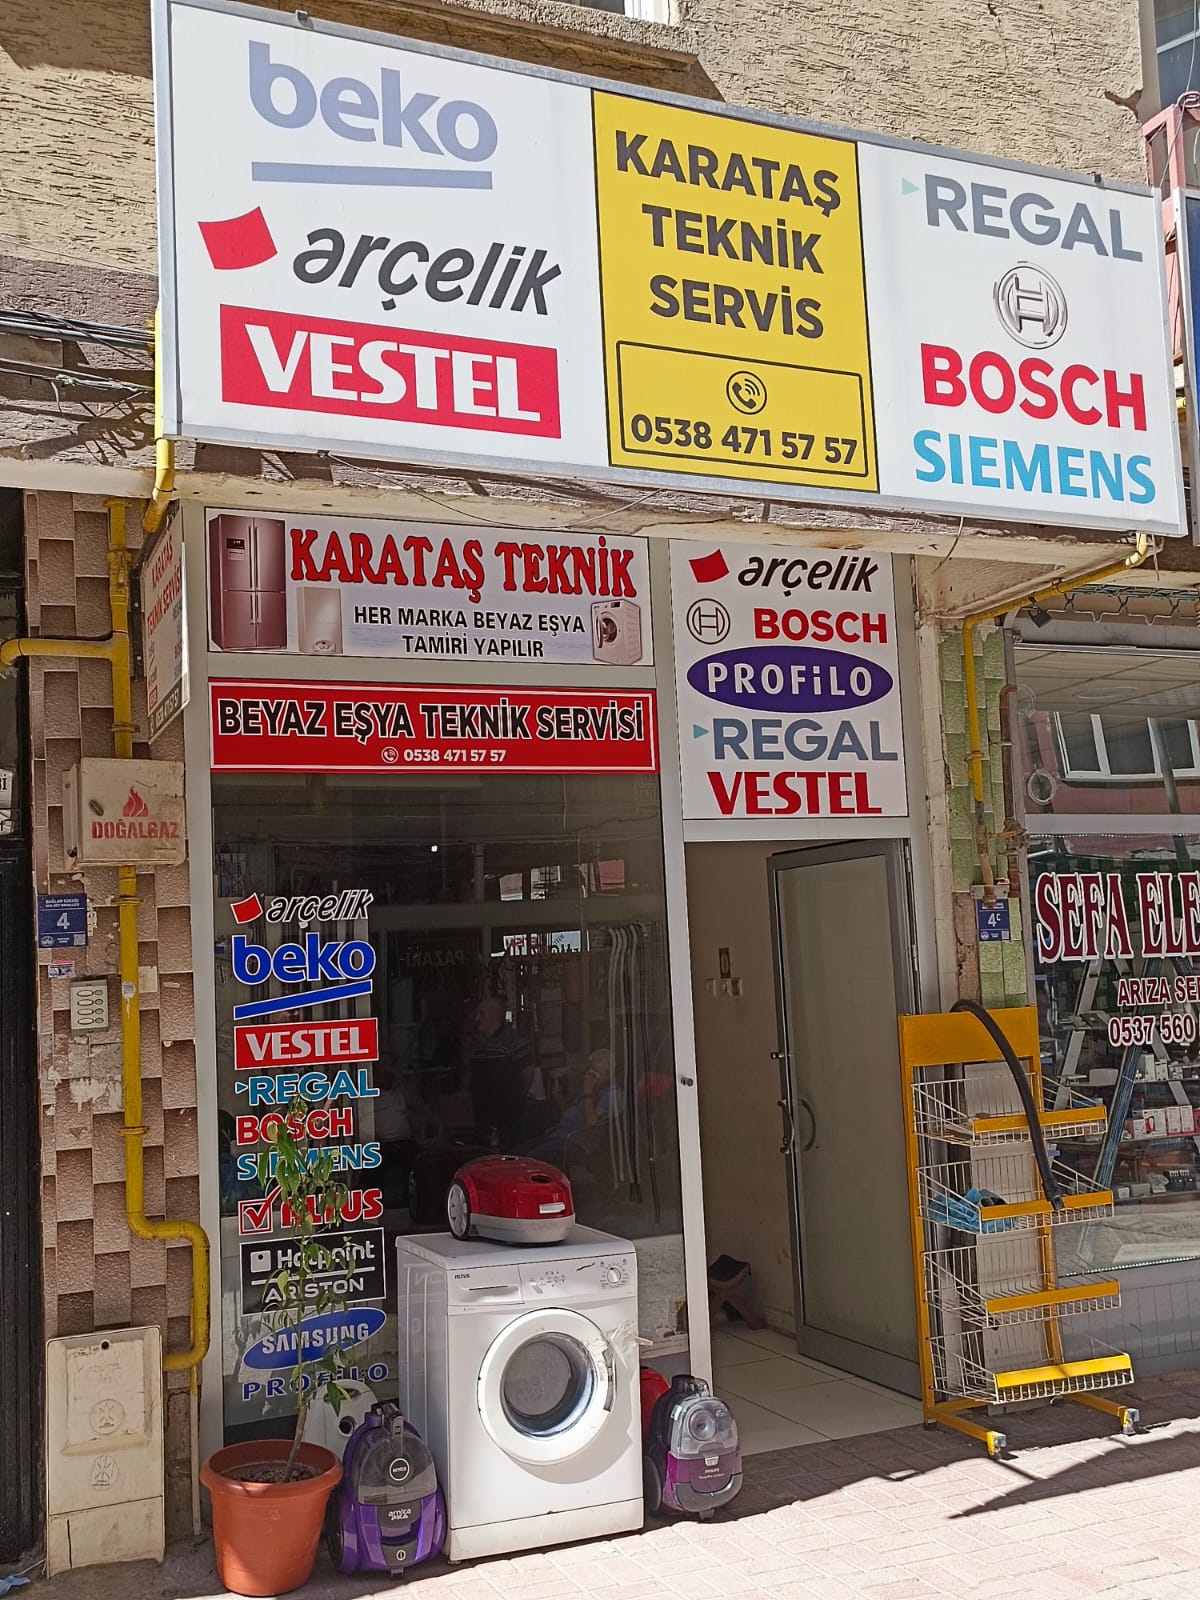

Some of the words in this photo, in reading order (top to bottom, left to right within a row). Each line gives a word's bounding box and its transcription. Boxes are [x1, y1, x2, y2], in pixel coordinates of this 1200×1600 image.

[248, 40, 498, 162] beko
[615, 130, 841, 218] KARATAŞ
[641, 203, 824, 274] TEKNİK
[924, 174, 1143, 263] REGAL
[292, 227, 561, 315] arçelik
[649, 274, 824, 339] SERVİS
[244, 323, 541, 423] VESTEL
[920, 343, 1147, 432] BOSCH
[631, 413, 712, 449] 0538
[721, 426, 772, 457] 471
[781, 431, 814, 460] 57
[824, 436, 858, 465] 57
[914, 429, 1156, 504] SIEMENS
[290, 528, 486, 604] KARATAŞ
[495, 536, 637, 598] TEKNİK
[738, 555, 879, 597] arçelik
[354, 606, 391, 626] HER
[398, 607, 467, 630] MARKA
[473, 612, 532, 632] BEYAZ
[538, 614, 585, 637] EŞYA
[753, 608, 888, 644] BOSCH
[402, 631, 467, 656] TAMİRİ
[475, 638, 544, 658] YAPILIR
[218, 698, 326, 738] BEYAZ
[333, 701, 416, 746] EŞYA
[419, 697, 531, 740] TEKNİK
[535, 700, 645, 742] SERVİSİ
[713, 718, 898, 761] REGAL
[403, 749, 440, 762] 0538
[444, 749, 468, 762] 471
[470, 749, 487, 762] 57
[490, 749, 506, 762] 57
[707, 772, 882, 815] VESTEL
[92, 818, 180, 839] DOĞALGAZ
[57, 912, 70, 930] 4
[266, 889, 374, 928] arçelik
[1035, 872, 1134, 964] SEFA
[232, 932, 376, 985] beko
[1117, 977, 1172, 1006] ARIZA
[1174, 976, 1200, 1004] SE
[245, 1027, 369, 1061] VESTEL
[1108, 1016, 1156, 1047] 0537
[1159, 1014, 1196, 1044] 560
[249, 1069, 380, 1106] REGAL
[235, 1107, 354, 1146] BOSCH
[237, 1143, 382, 1181] SEMENS
[265, 1278, 364, 1304] ARSTON
[262, 1323, 369, 1354] SAMSUNG
